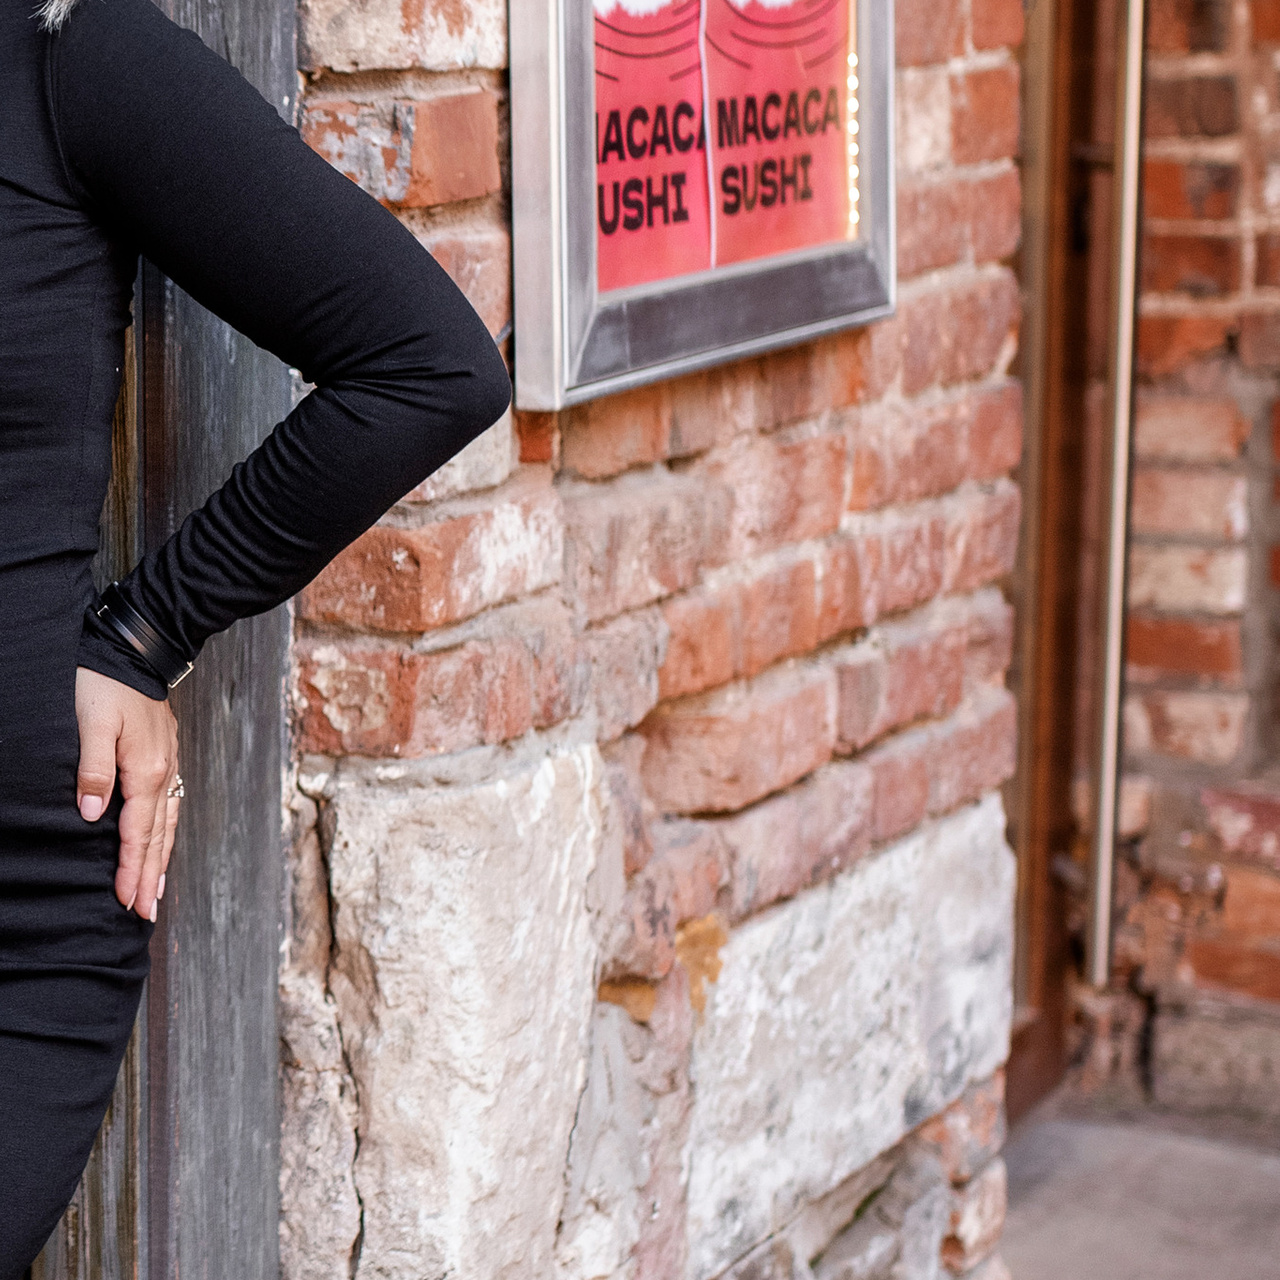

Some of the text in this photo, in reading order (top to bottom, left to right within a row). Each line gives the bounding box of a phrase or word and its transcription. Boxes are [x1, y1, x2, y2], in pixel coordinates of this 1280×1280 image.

[596, 101, 706, 164] ACAC
[717, 87, 840, 149] MACACA
[721, 153, 813, 215] SUSHI
